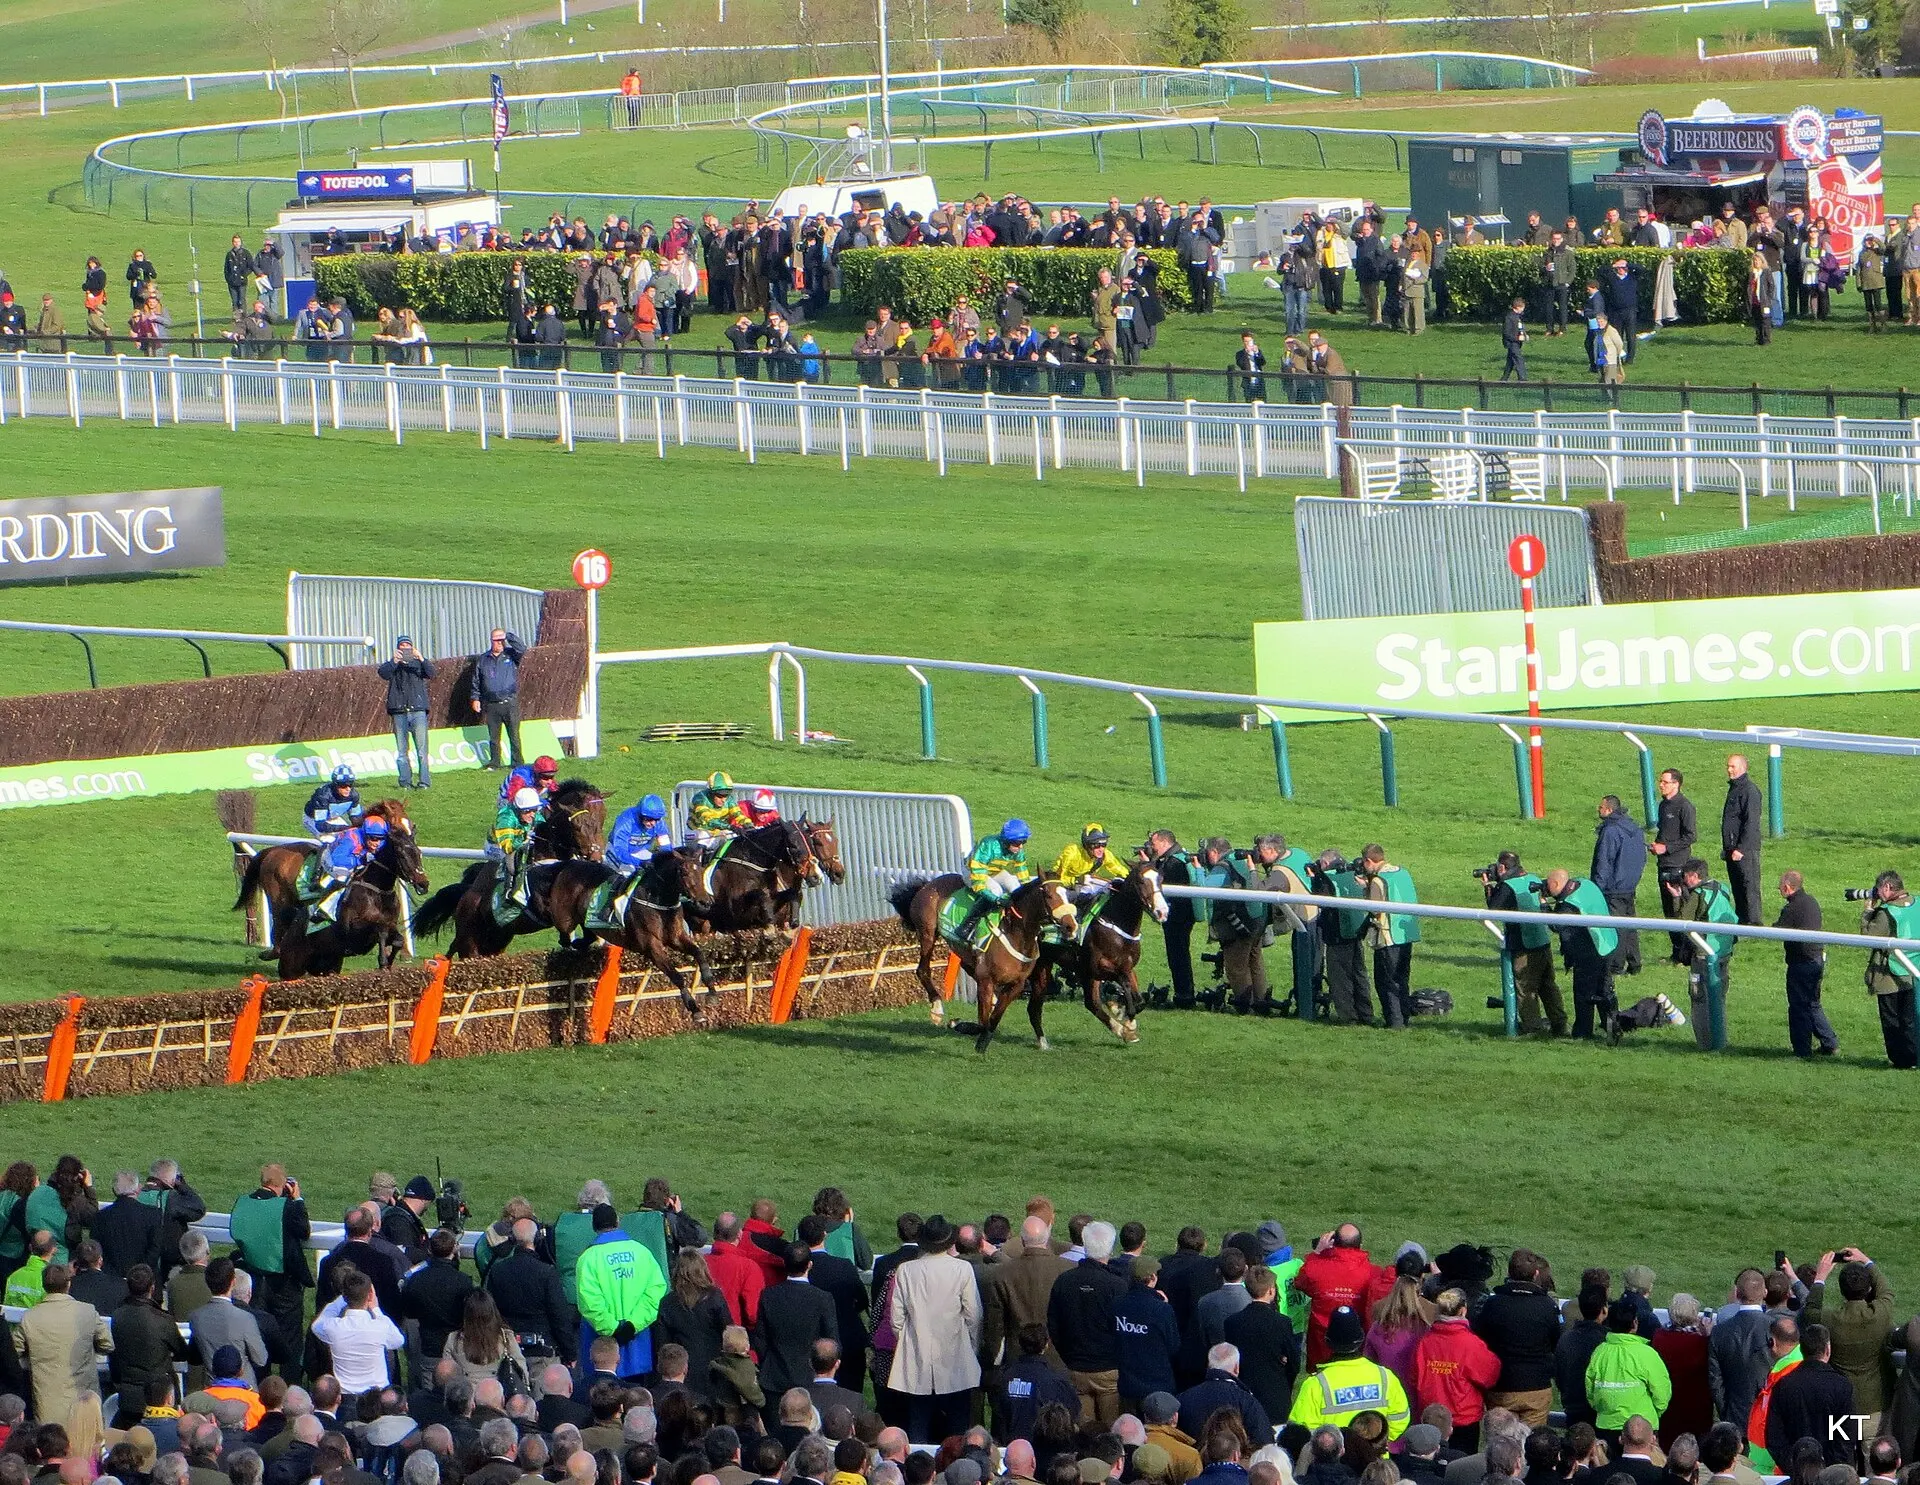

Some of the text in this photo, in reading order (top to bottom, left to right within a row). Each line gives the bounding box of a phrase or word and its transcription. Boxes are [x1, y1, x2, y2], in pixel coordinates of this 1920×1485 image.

[1673, 128, 1775, 153] BEEFBURGERS
[1845, 128, 1866, 137] FOOD
[323, 176, 389, 189] TOTEPOOL
[1836, 194, 1869, 212] BRITISH
[1519, 541, 1532, 572] 1
[580, 555, 606, 584] 16
[606, 1251, 635, 1265] GREEN
[612, 1267, 634, 1280] TEAM
[1115, 1315, 1149, 1335] Novae
[1336, 1385, 1378, 1403] POLICE
